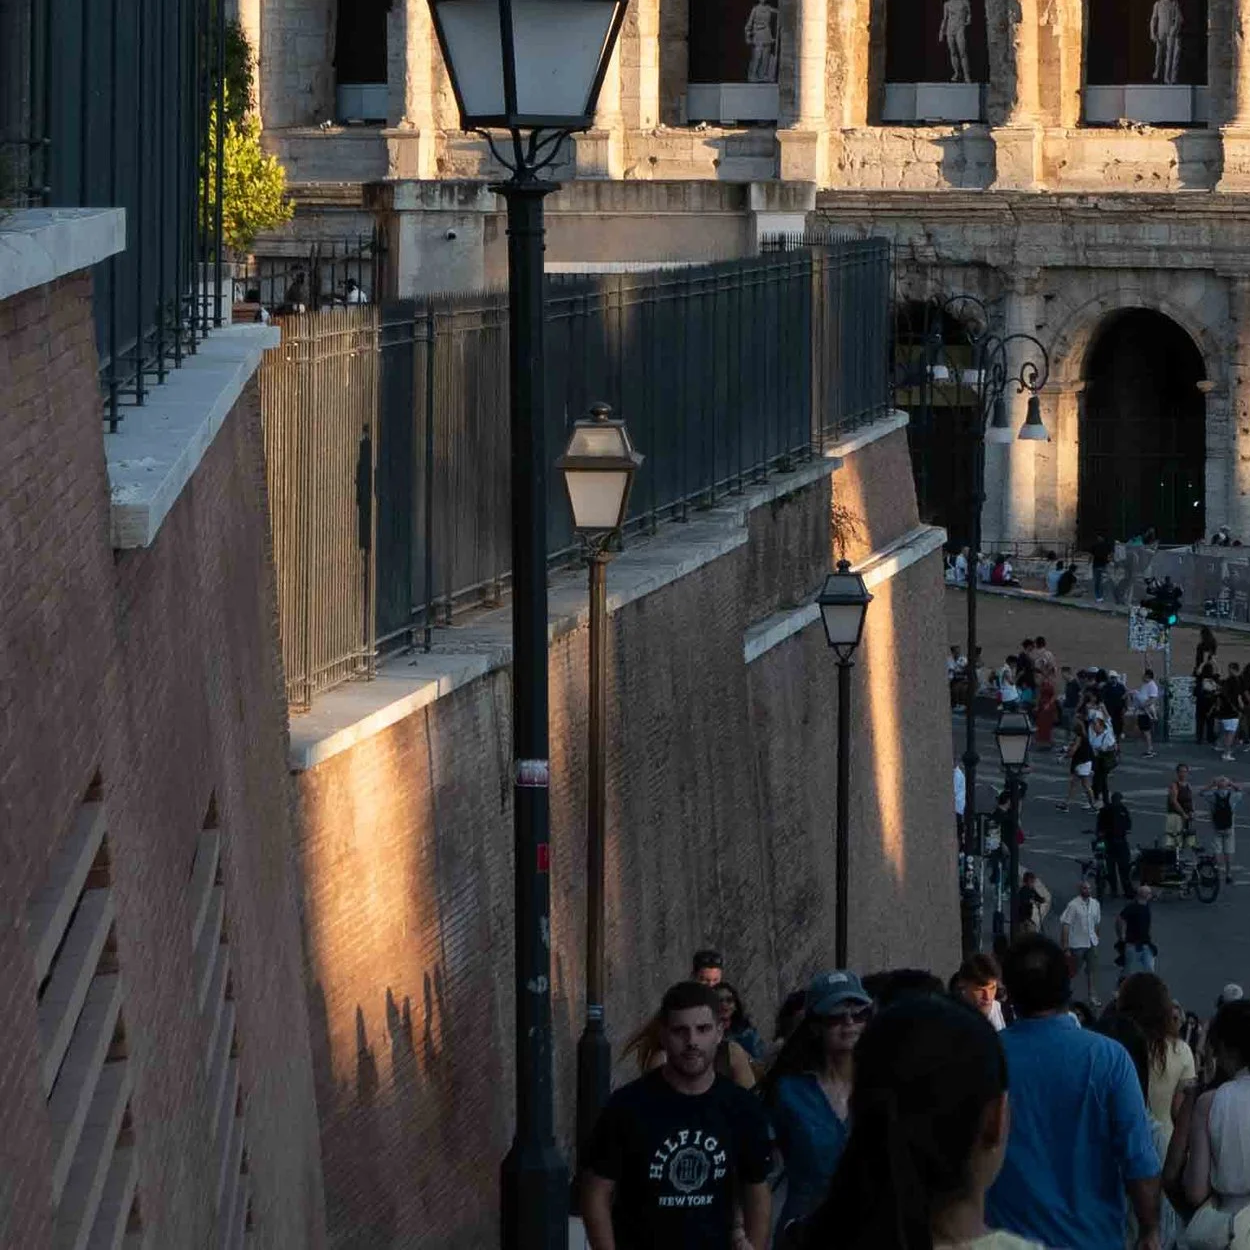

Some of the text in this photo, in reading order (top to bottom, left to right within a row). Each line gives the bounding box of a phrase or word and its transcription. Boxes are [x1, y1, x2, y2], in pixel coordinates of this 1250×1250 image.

[649, 1129, 727, 1181] HILFIGER
[658, 1194, 715, 1207] NEW YORK
